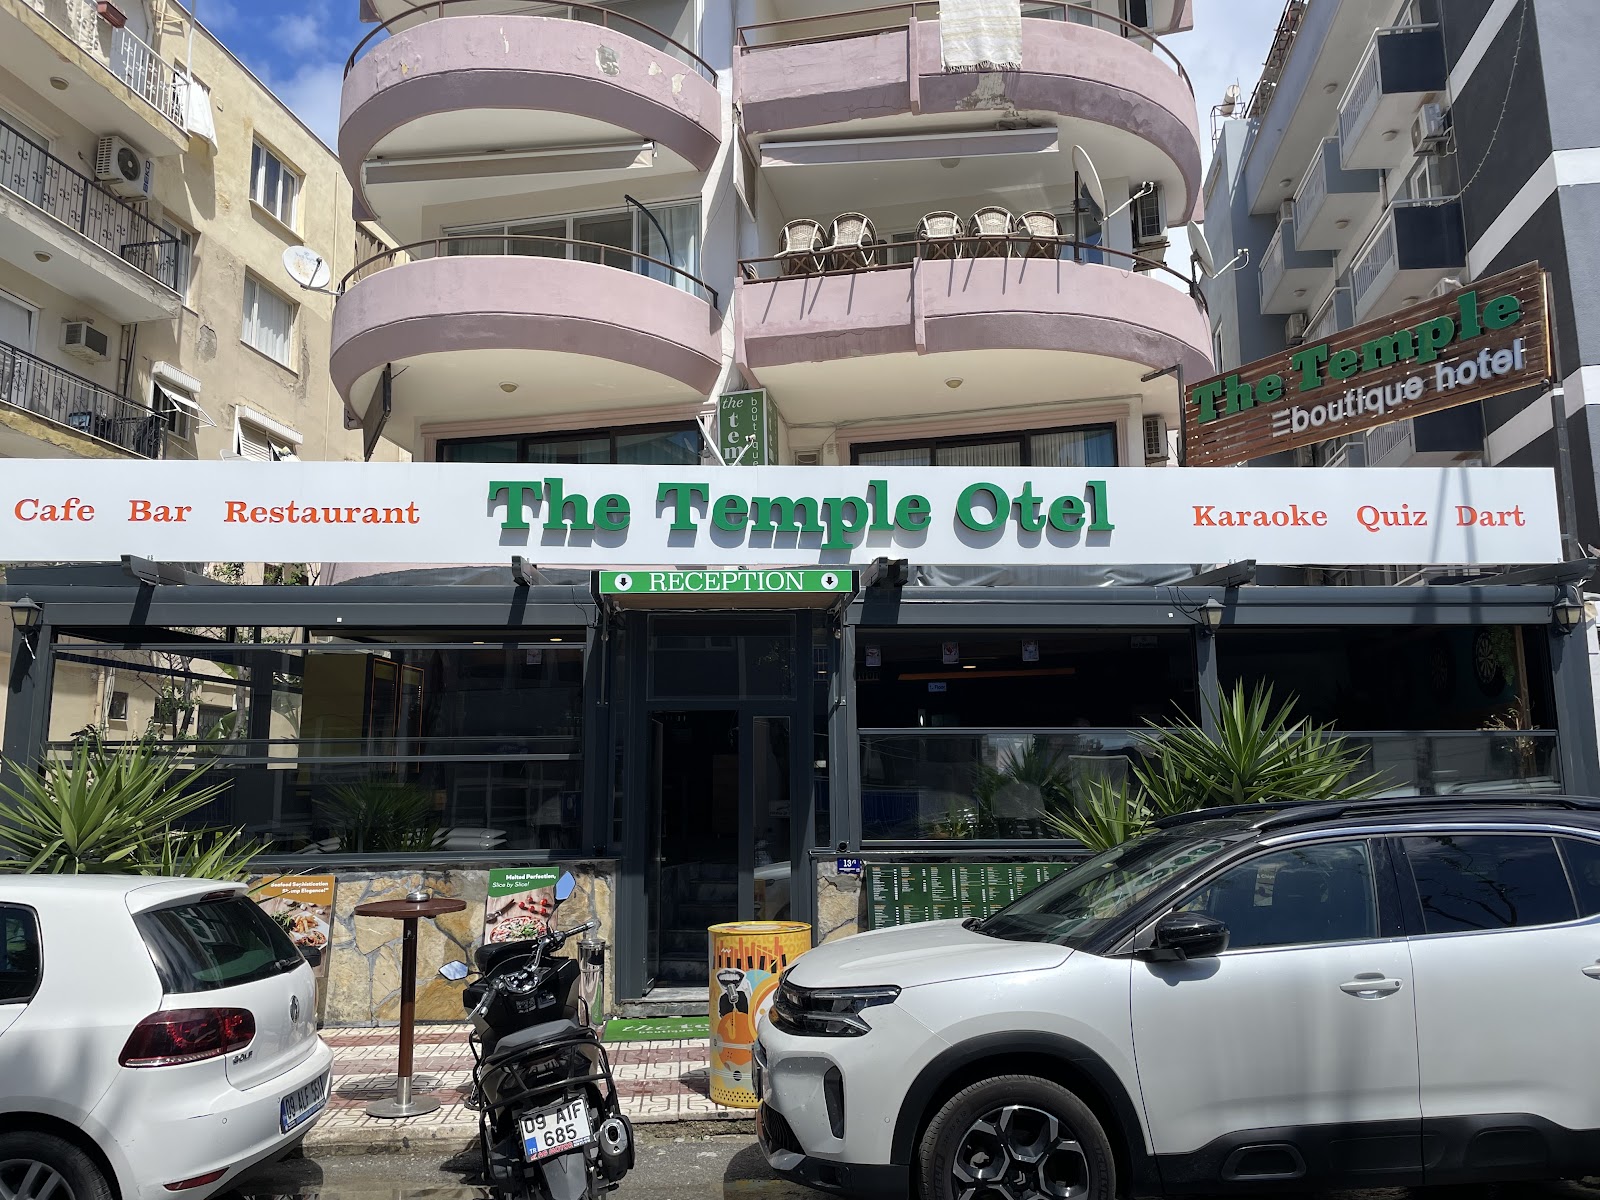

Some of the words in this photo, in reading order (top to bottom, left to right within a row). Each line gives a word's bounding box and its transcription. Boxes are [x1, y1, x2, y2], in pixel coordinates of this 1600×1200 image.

[143, 160, 151, 193] BEKO
[1192, 372, 1285, 424] The
[1292, 290, 1523, 391] Temple
[1290, 376, 1424, 434] boutique
[1435, 337, 1526, 393] hotel
[722, 397, 744, 409] the
[723, 412, 744, 465] tem
[751, 397, 759, 465] boutque
[14, 497, 95, 522] Cafe
[128, 499, 192, 523] Bar
[224, 500, 420, 525] Restaurant
[488, 477, 630, 531] The
[656, 479, 932, 550] Temple
[956, 480, 1115, 532] Otel
[1192, 504, 1328, 527] Karaoke
[1356, 504, 1428, 533] Quiz
[1455, 504, 1526, 527] Dart
[649, 571, 804, 591] RECEPTION
[506, 881, 514, 889] by
[232, 1050, 253, 1065] GOLF
[286, 1096, 296, 1120] 09
[524, 1113, 548, 1133] 09
[556, 1102, 582, 1124] AIF
[543, 1123, 578, 1146] 685
